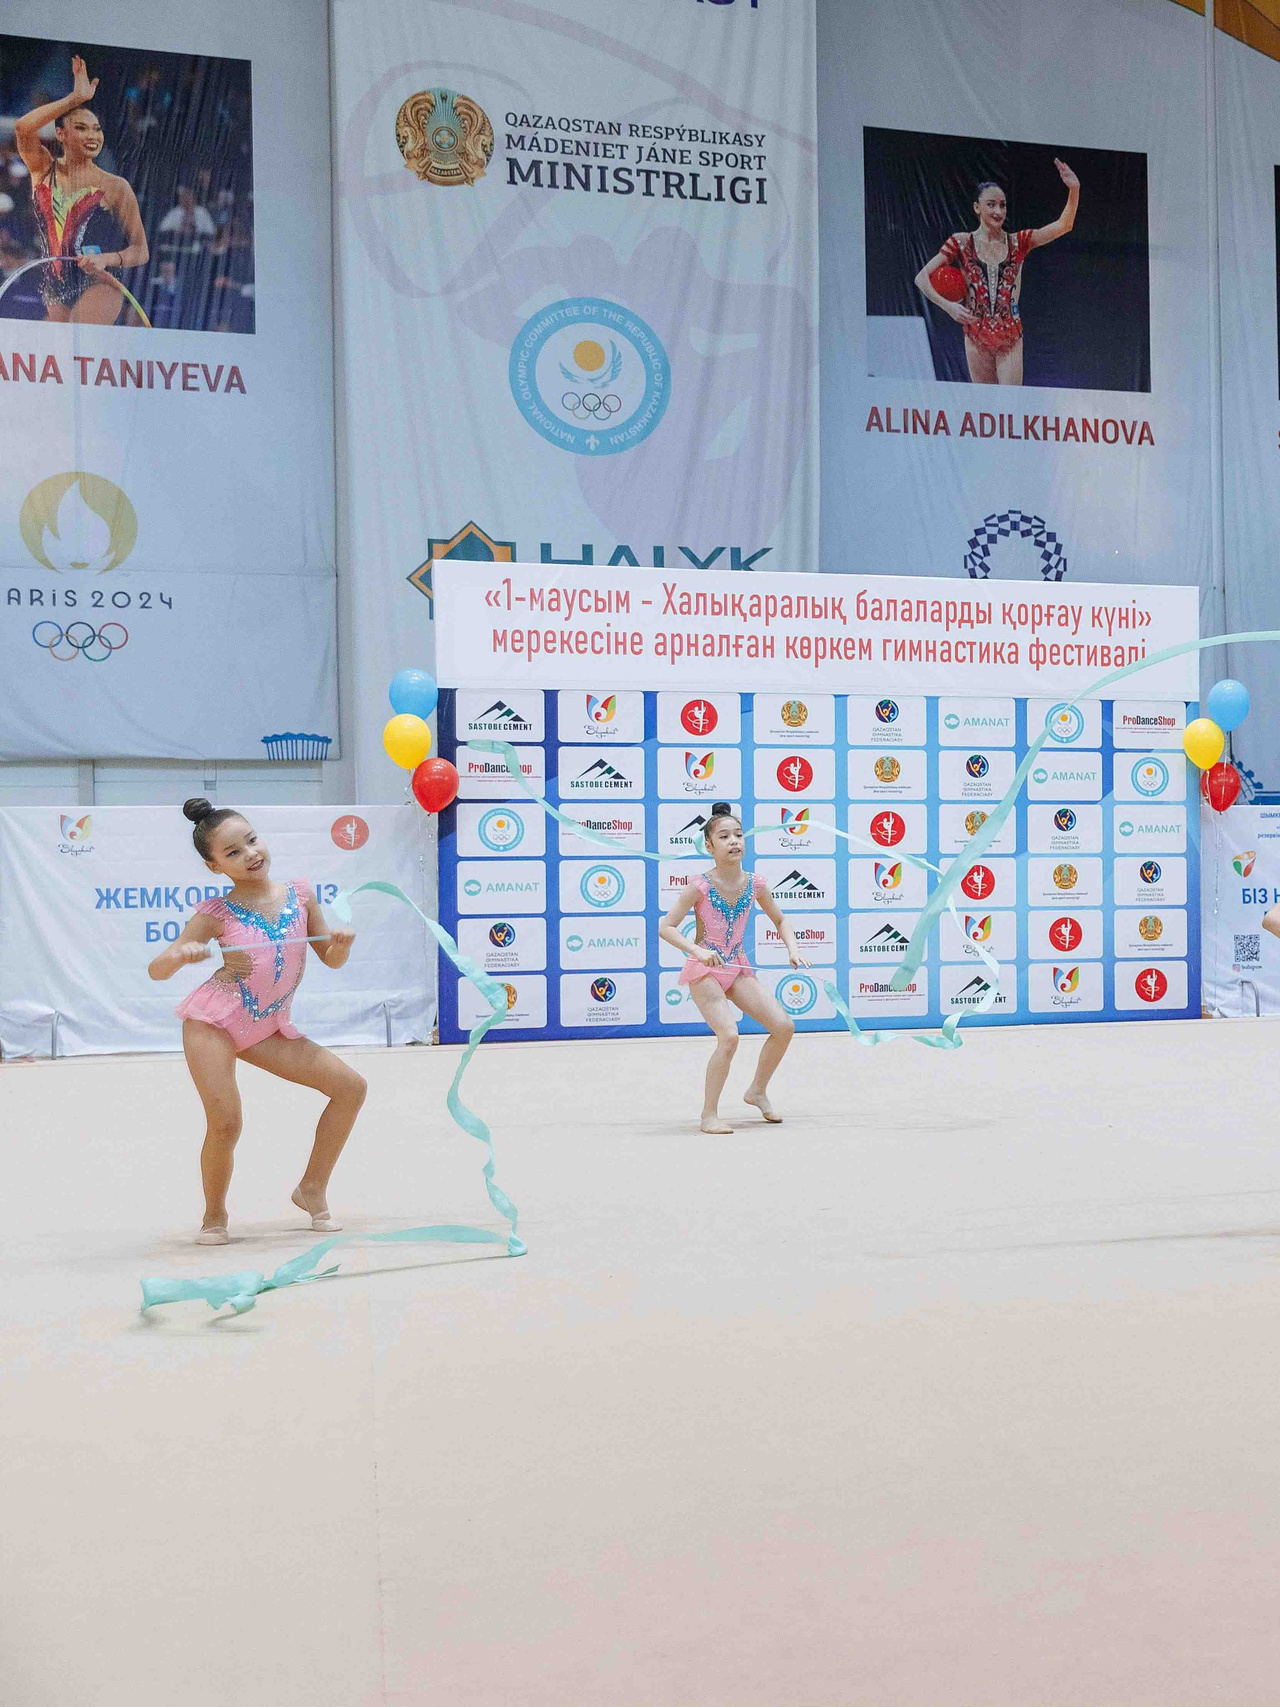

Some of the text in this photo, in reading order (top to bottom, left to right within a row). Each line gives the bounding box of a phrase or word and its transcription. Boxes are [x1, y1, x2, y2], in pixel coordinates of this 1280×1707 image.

[505, 112, 766, 147] QAZAQSTAN RESPÝBLIKASY
[505, 132, 767, 171] MÁDENIET JÁNE SPORT
[506, 157, 768, 205] MINISTRLIGI
[74, 355, 247, 394] TANIYEVA
[518, 305, 664, 446] NATIONAL OLYMPIC COMMITTEE OF THE REPUBLIC OF KAZAKHSTAN
[866, 406, 1155, 447] ALINA ADILKHANOVA
[91, 590, 173, 609] 2024
[485, 578, 630, 621] «1-маусым
[662, 582, 847, 627] Халықаралық
[855, 590, 993, 632] балаларды
[1002, 602, 1083, 636] қорғау
[1091, 599, 1152, 637] күні»
[492, 623, 1146, 671] мерекесіне арналған көркем гимнастика фестивалі
[963, 717, 1010, 727] AMANAT
[1122, 715, 1176, 727] ProDanceShop
[468, 762, 533, 774] ProDancop
[1051, 772, 1097, 781] AMANAT
[572, 820, 633, 832] oDanceShop
[1137, 825, 1182, 834] AMANAT
[670, 836, 693, 845] SASTO
[486, 882, 540, 892] AMANAT
[771, 891, 797, 899] ASTOBE
[1242, 887, 1268, 904] БІЗ
[766, 929, 825, 941] ProceShop
[588, 938, 640, 948] AMANAT
